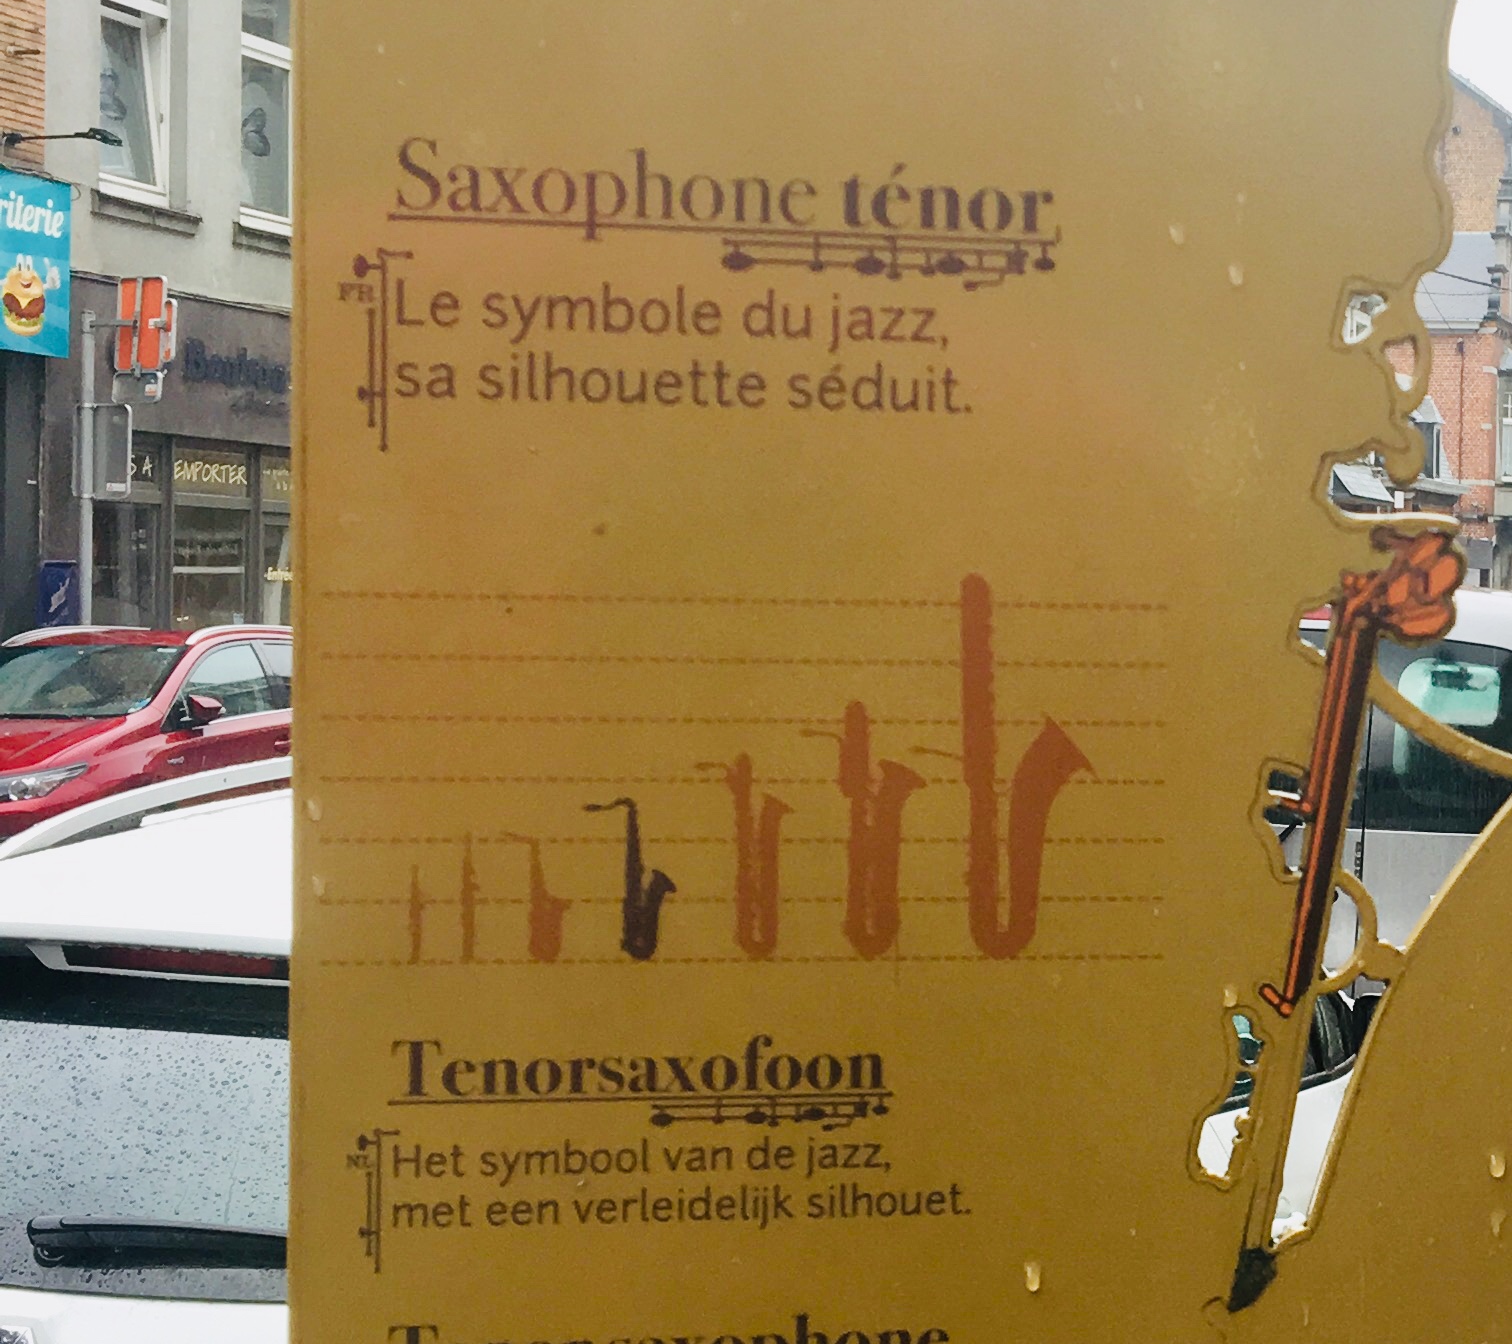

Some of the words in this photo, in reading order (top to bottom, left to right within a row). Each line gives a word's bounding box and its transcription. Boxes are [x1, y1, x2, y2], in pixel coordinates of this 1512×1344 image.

[396, 136, 817, 242] Saxophone
[843, 162, 1057, 234] ténor
[338, 282, 375, 304] FR
[396, 278, 460, 327] Le
[482, 281, 722, 345] symbole
[742, 288, 812, 339] du
[828, 292, 949, 354] jazz,
[395, 362, 457, 399] sa
[477, 350, 767, 408] silhouette
[788, 361, 973, 414] séduit.
[173, 460, 247, 485] EMPORTER
[391, 1033, 886, 1097] Tenorsaxofoon
[392, 1144, 464, 1178] Het
[479, 1137, 649, 1188] symbool
[663, 1144, 733, 1172] van
[747, 1136, 795, 1171] de
[806, 1137, 892, 1179] jazz,
[392, 1194, 471, 1228] met
[485, 1199, 559, 1226] een
[572, 1184, 794, 1230] verleidelijk
[807, 1182, 972, 1219] silhouet.
